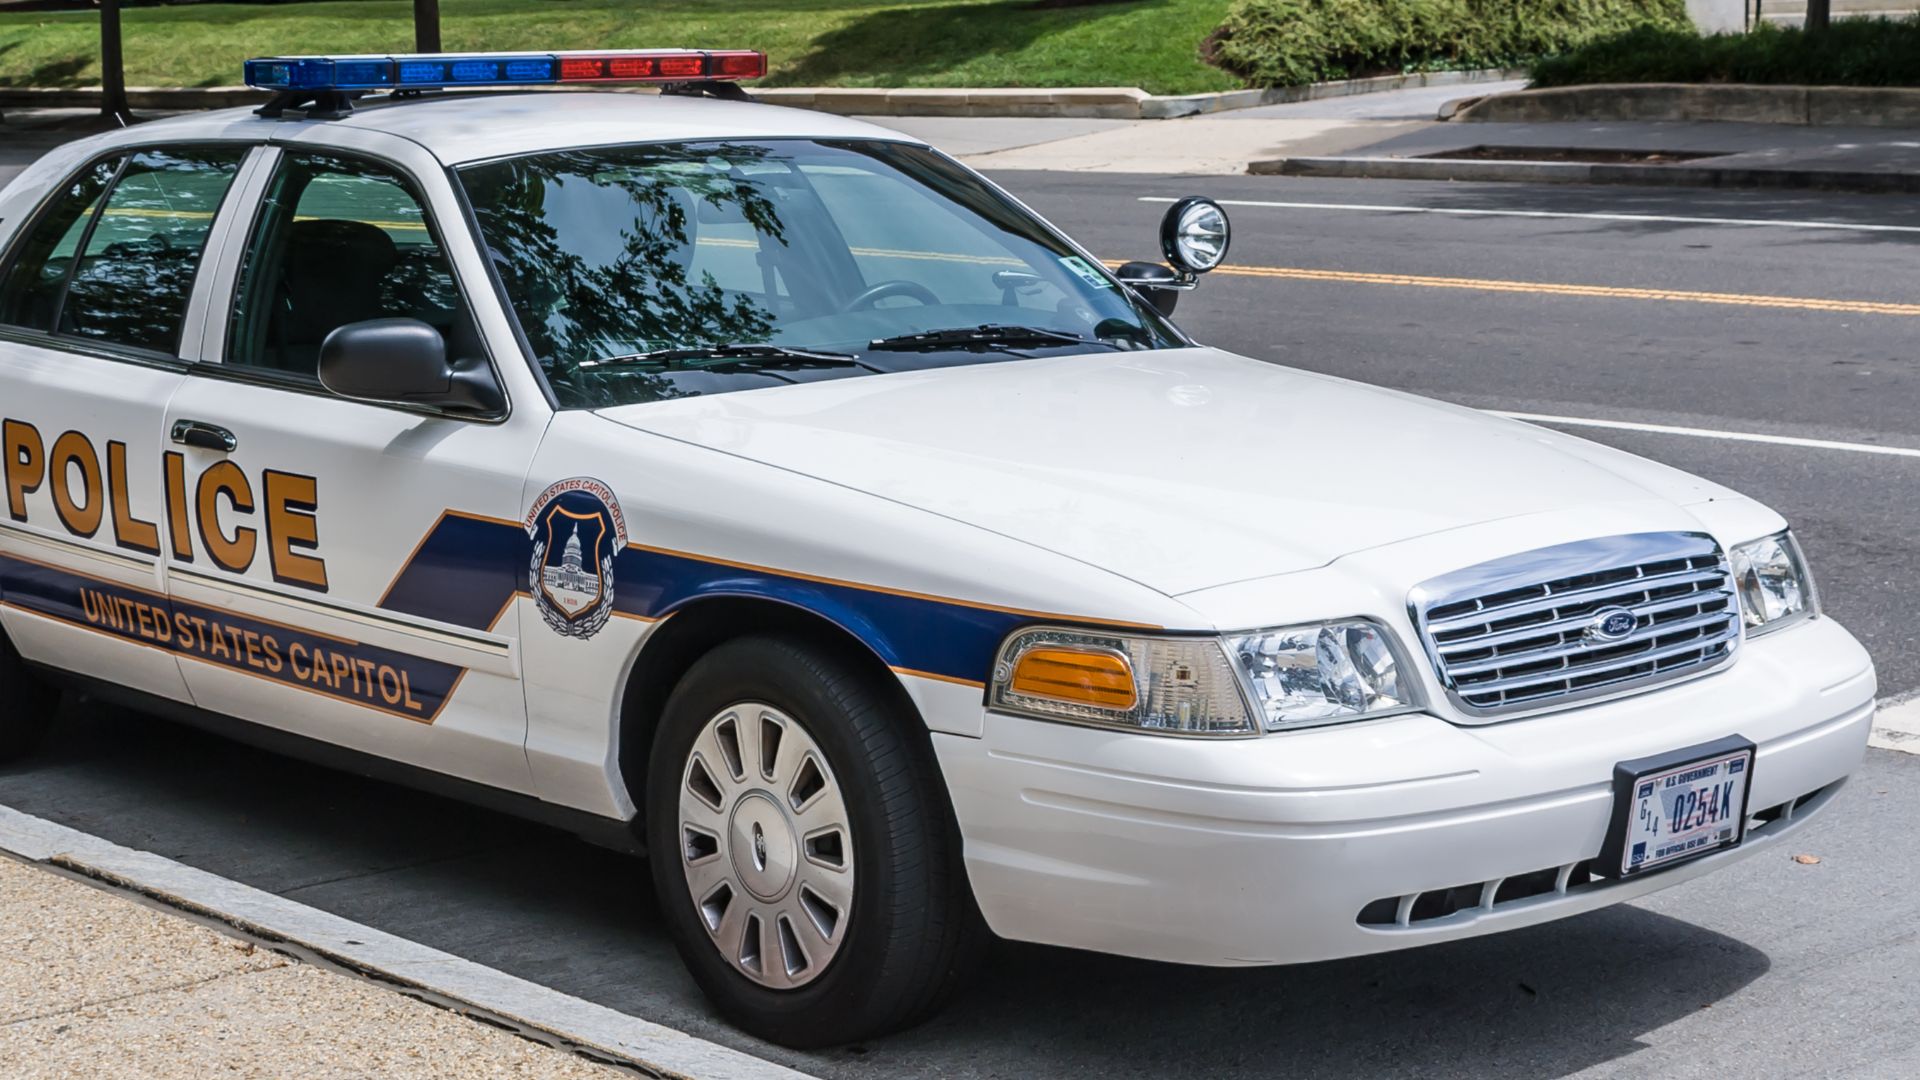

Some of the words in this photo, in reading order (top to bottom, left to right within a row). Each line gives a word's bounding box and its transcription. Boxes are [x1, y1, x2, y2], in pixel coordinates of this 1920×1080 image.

[3, 418, 328, 593] POLICE
[524, 493, 549, 529] UNITED
[550, 480, 581, 498] STATES
[582, 480, 610, 505] CAPITOL
[609, 504, 626, 541] POLICE
[80, 587, 172, 642] UNITED
[175, 611, 282, 673] STATES
[290, 642, 422, 711] CAPITOL
[1608, 617, 1630, 632] Ford
[1678, 764, 1719, 784] GOVERNMENT
[1672, 780, 1734, 834] 0254K
